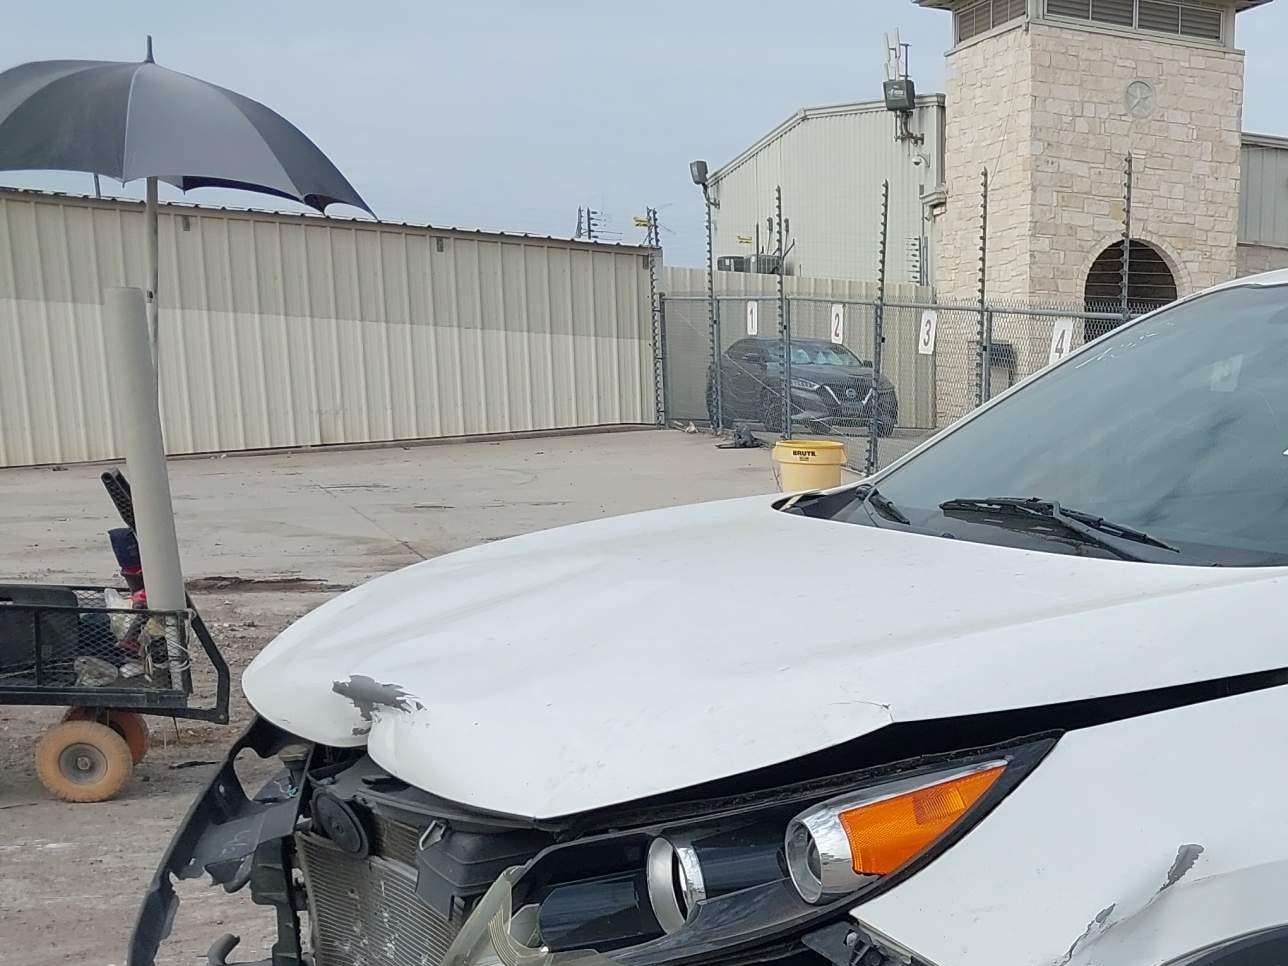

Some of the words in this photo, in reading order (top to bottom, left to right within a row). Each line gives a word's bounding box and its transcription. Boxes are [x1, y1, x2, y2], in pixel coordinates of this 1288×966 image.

[833, 312, 840, 338] 2
[923, 318, 932, 347] 3
[1054, 328, 1066, 359] 4
